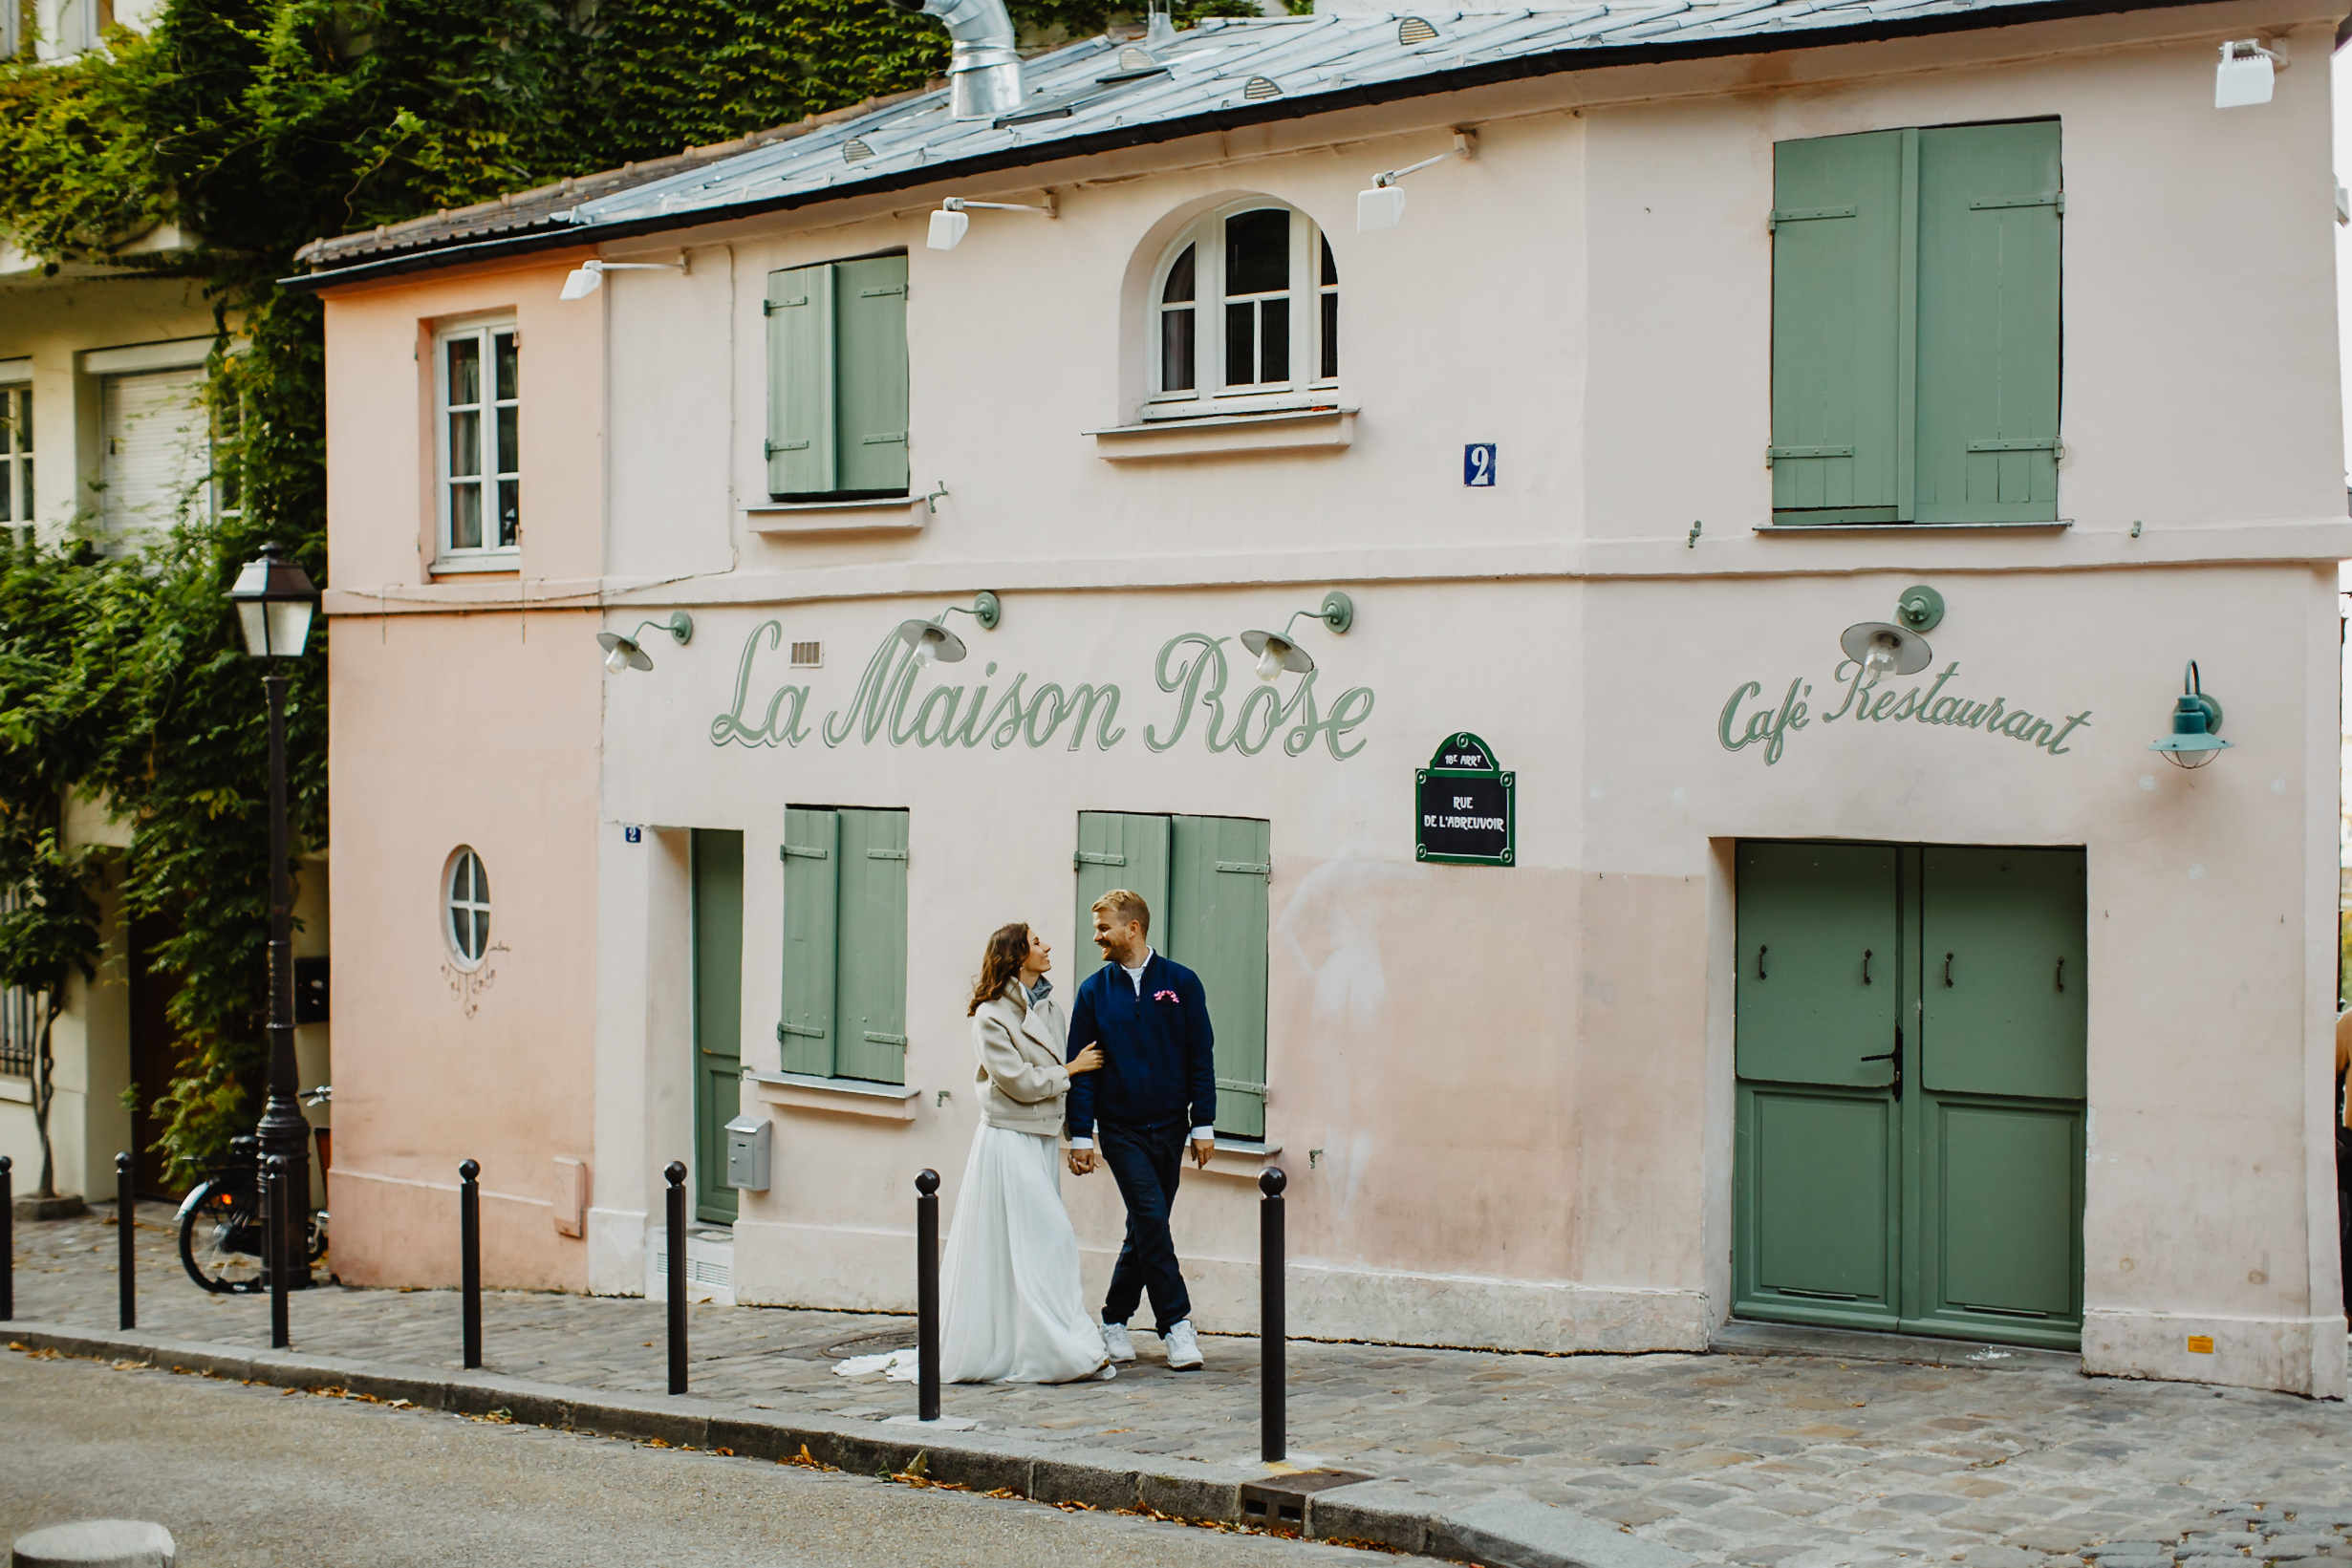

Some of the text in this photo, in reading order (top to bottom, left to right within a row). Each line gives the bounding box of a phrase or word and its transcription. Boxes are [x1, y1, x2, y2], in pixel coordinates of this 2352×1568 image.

[1471, 446, 1489, 485] 2
[709, 614, 1375, 762] La Maison Rose
[1718, 659, 2093, 766] Café Restaurant
[1453, 796, 1473, 810] RUE
[629, 827, 637, 842] 2
[1424, 814, 1504, 832] DE L'ABREUVOIR
